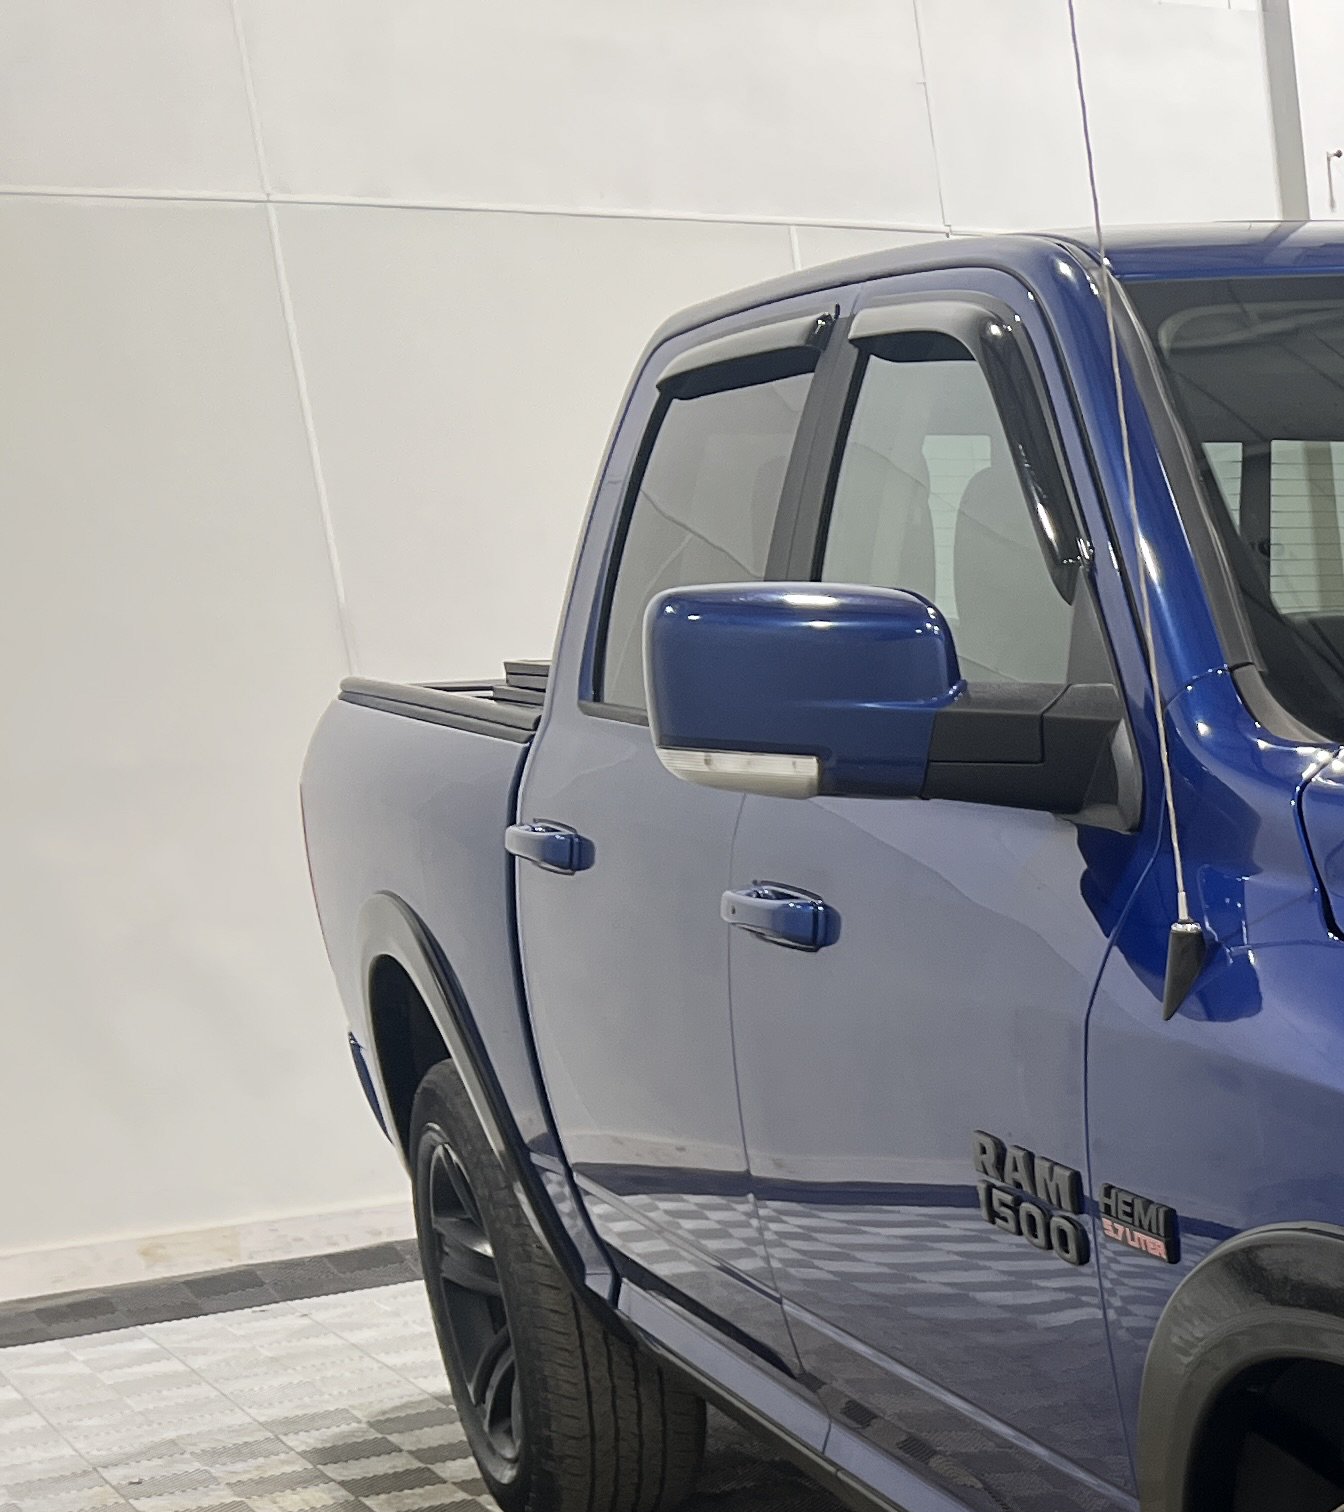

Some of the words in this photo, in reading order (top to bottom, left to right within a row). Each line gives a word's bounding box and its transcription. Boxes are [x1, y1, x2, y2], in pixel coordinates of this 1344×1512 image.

[973, 1130, 1083, 1214] RAM
[1099, 1182, 1168, 1237] HEMI
[976, 1179, 1090, 1265] 1500
